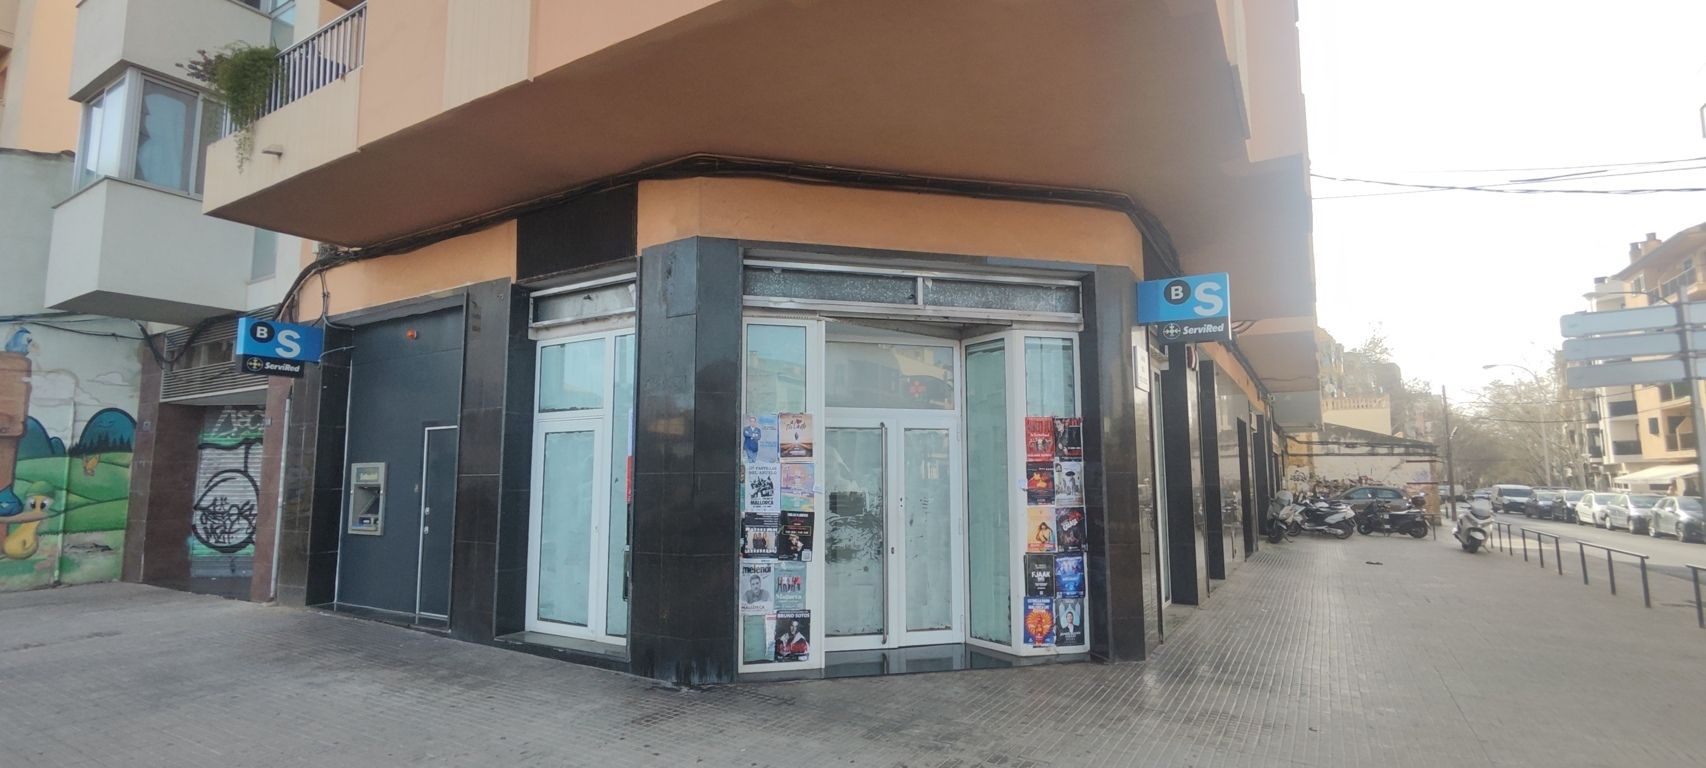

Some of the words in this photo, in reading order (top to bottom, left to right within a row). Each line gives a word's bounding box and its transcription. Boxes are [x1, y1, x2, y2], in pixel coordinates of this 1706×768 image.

[1170, 285, 1184, 300] B
[1193, 281, 1224, 316] S
[1182, 323, 1225, 335] ServiRed
[256, 326, 268, 339] B
[275, 329, 301, 358] S
[264, 362, 300, 373] ServiRed
